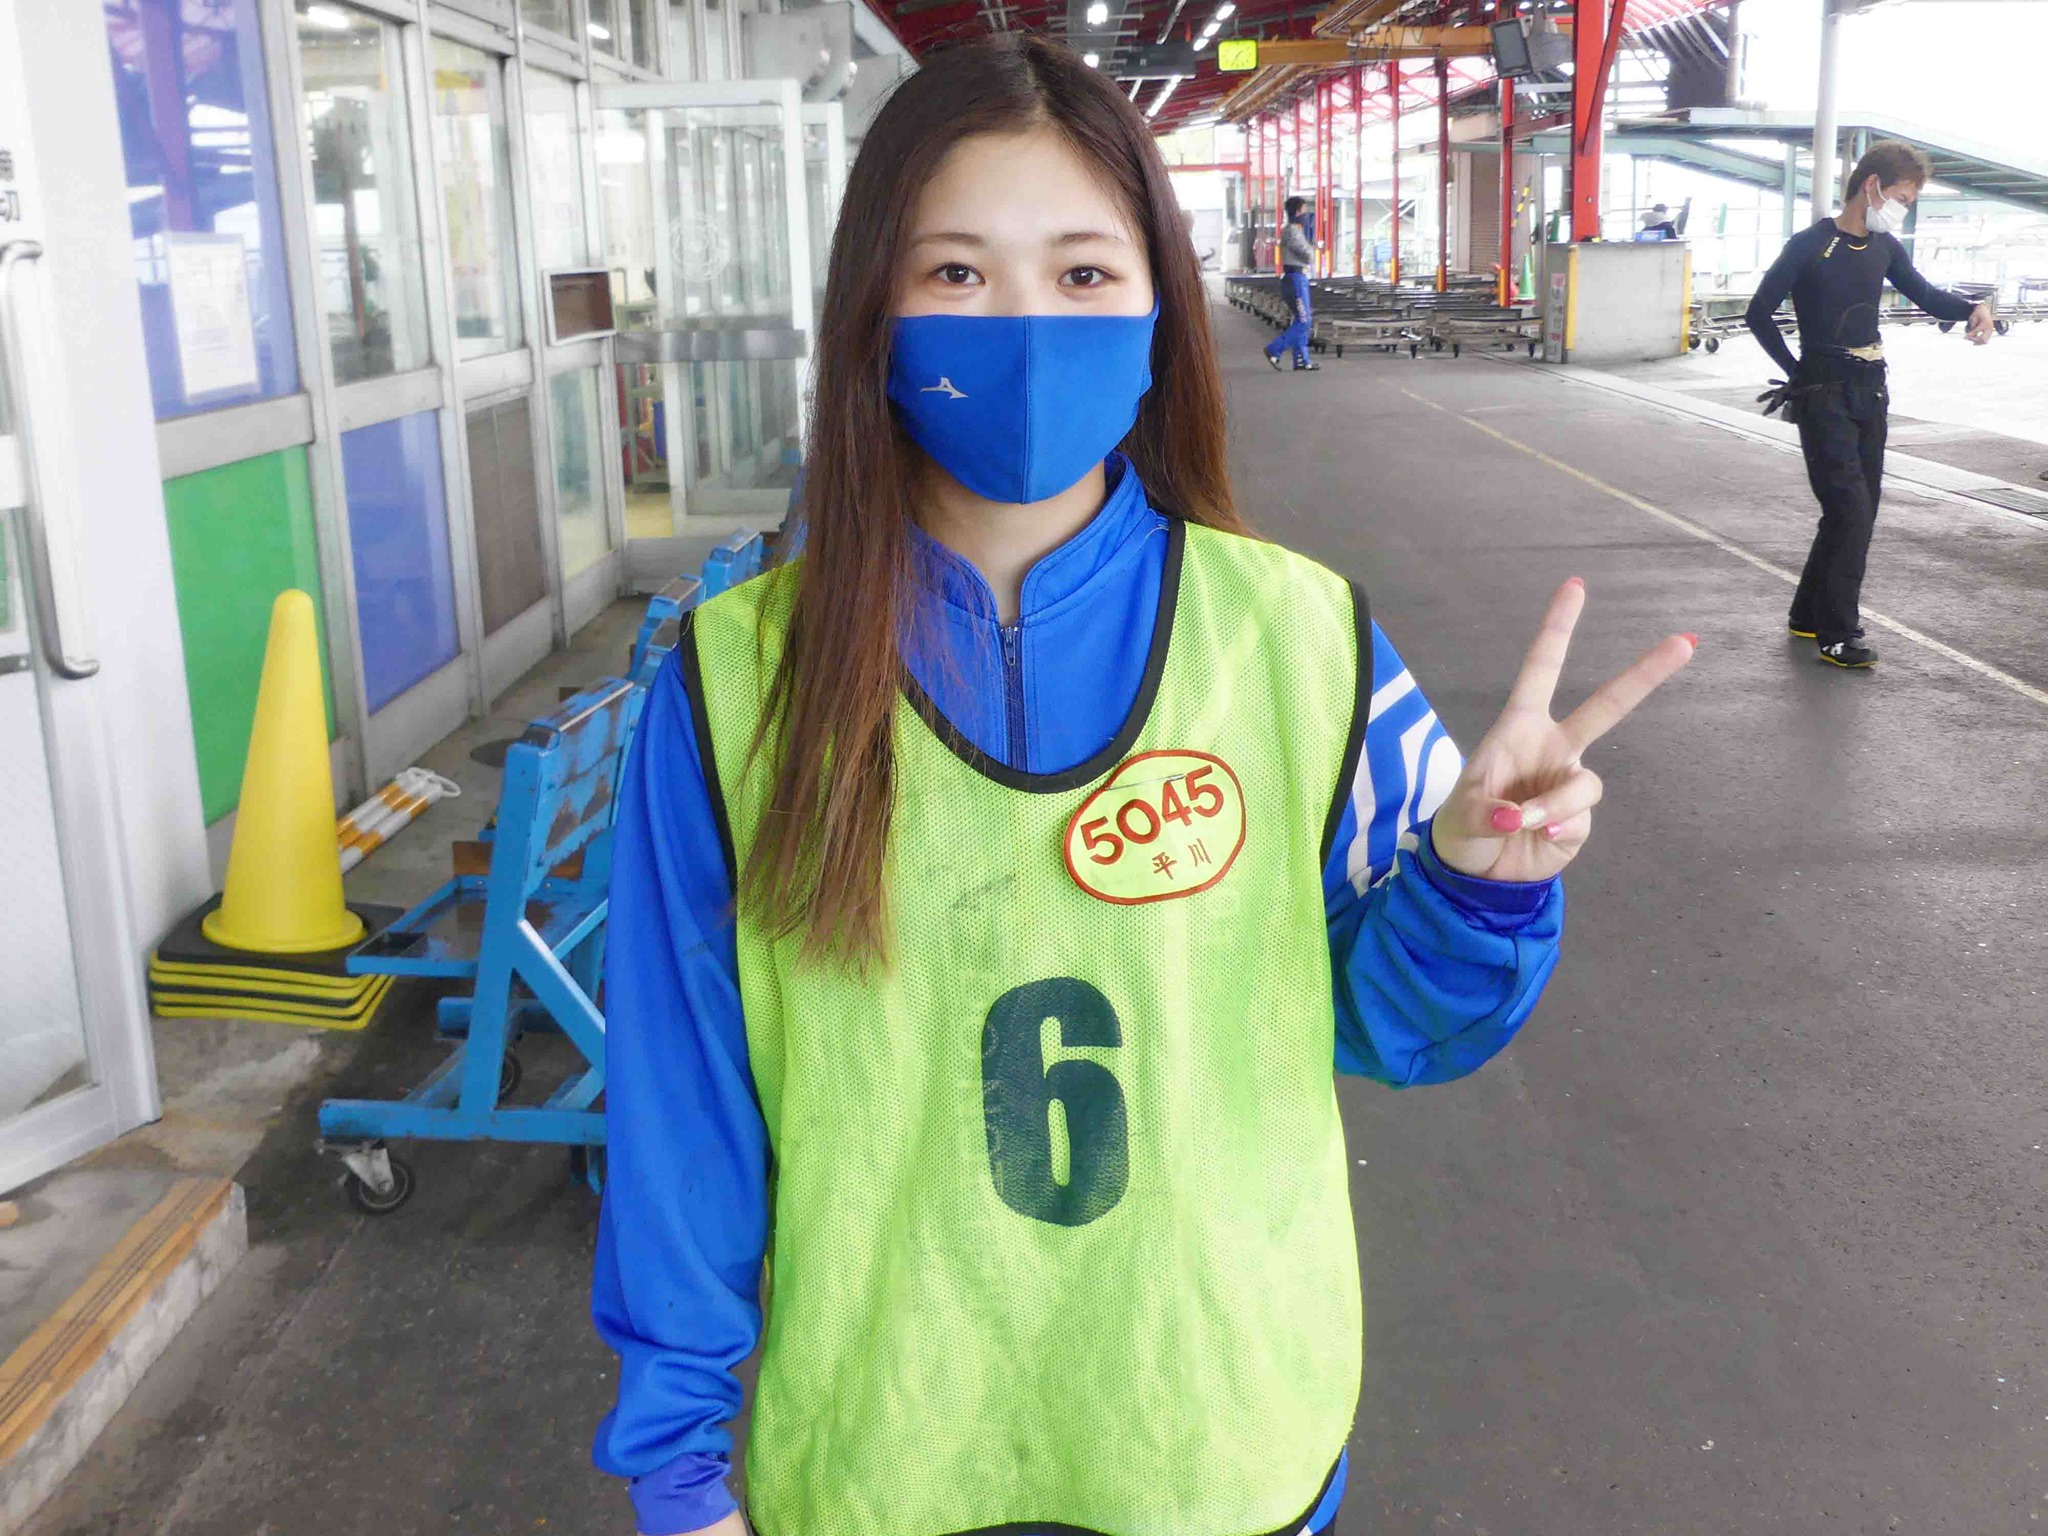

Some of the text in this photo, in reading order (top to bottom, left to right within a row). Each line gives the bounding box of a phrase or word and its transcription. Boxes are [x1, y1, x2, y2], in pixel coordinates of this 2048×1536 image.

[1080, 765, 1224, 865] 5045
[1152, 838, 1212, 880] 平川
[981, 976, 1130, 1227] 6
